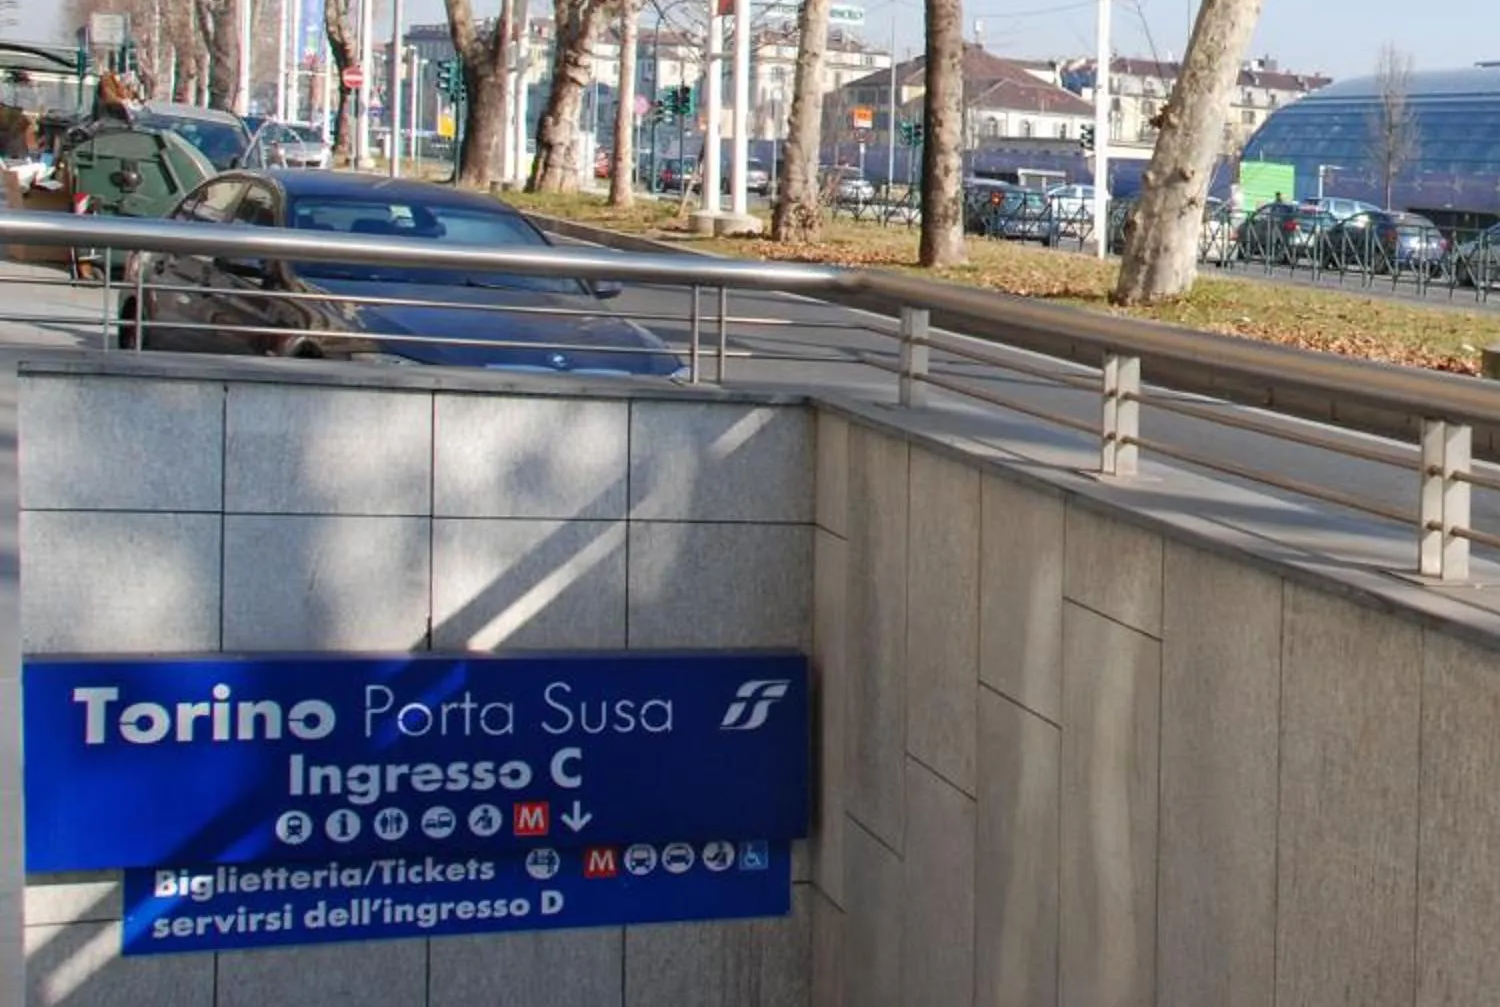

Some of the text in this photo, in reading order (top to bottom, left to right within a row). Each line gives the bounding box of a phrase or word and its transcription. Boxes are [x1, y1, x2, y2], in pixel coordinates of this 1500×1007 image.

[73, 681, 673, 744] Torino Porta Susa
[289, 747, 583, 805] Ingresso C
[154, 856, 496, 902] Biglietteria/Tickets
[152, 890, 565, 939] servirsi dell'ingresso D
